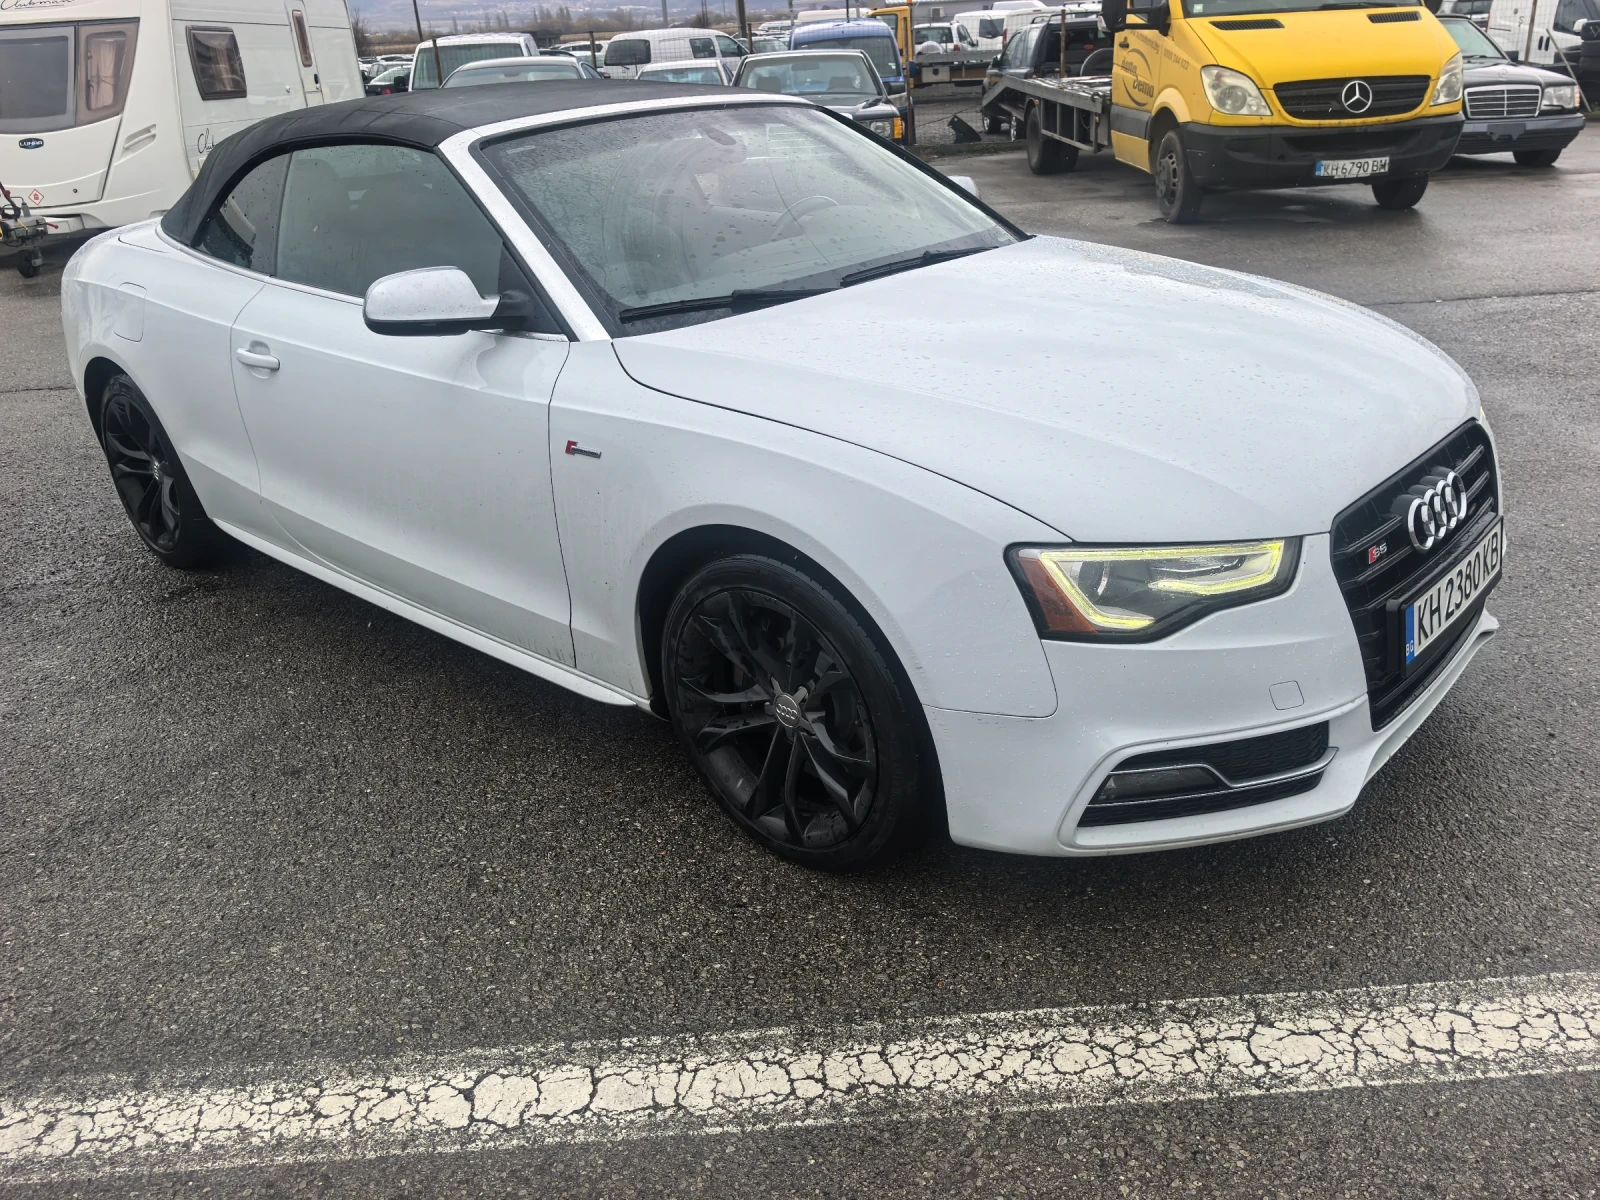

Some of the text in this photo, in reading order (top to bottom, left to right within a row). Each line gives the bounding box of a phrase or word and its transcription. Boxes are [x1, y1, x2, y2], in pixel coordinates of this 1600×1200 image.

[1341, 161, 1369, 174] 6790
[1371, 542, 1387, 560] S5
[1418, 532, 1499, 646] KH 2380 KB
[1405, 640, 1414, 656] BG
